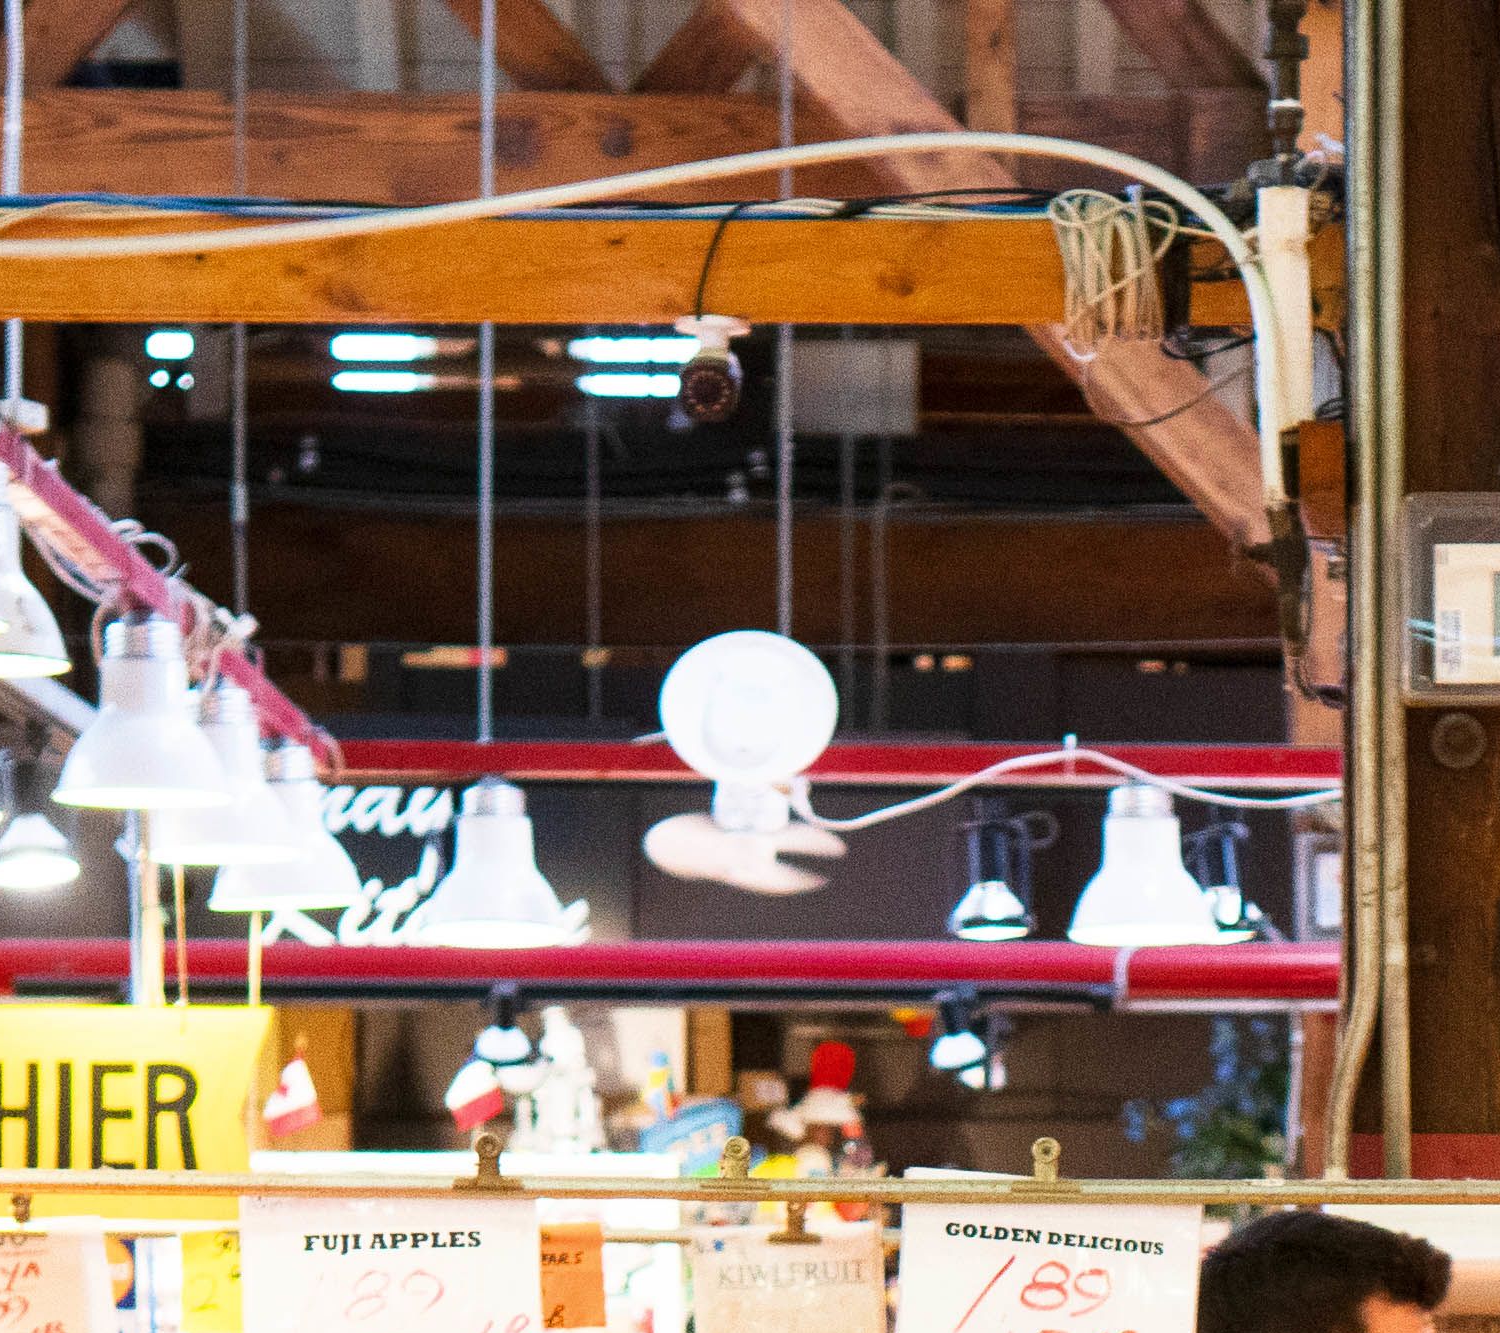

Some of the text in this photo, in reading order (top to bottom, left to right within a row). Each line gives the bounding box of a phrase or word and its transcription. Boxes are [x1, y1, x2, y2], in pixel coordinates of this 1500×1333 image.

[304, 1230, 481, 1255] FUJI APPLES
[945, 1221, 1165, 1256] GOLDEN DELICIOUS
[786, 1258, 865, 1286] FRUIT
